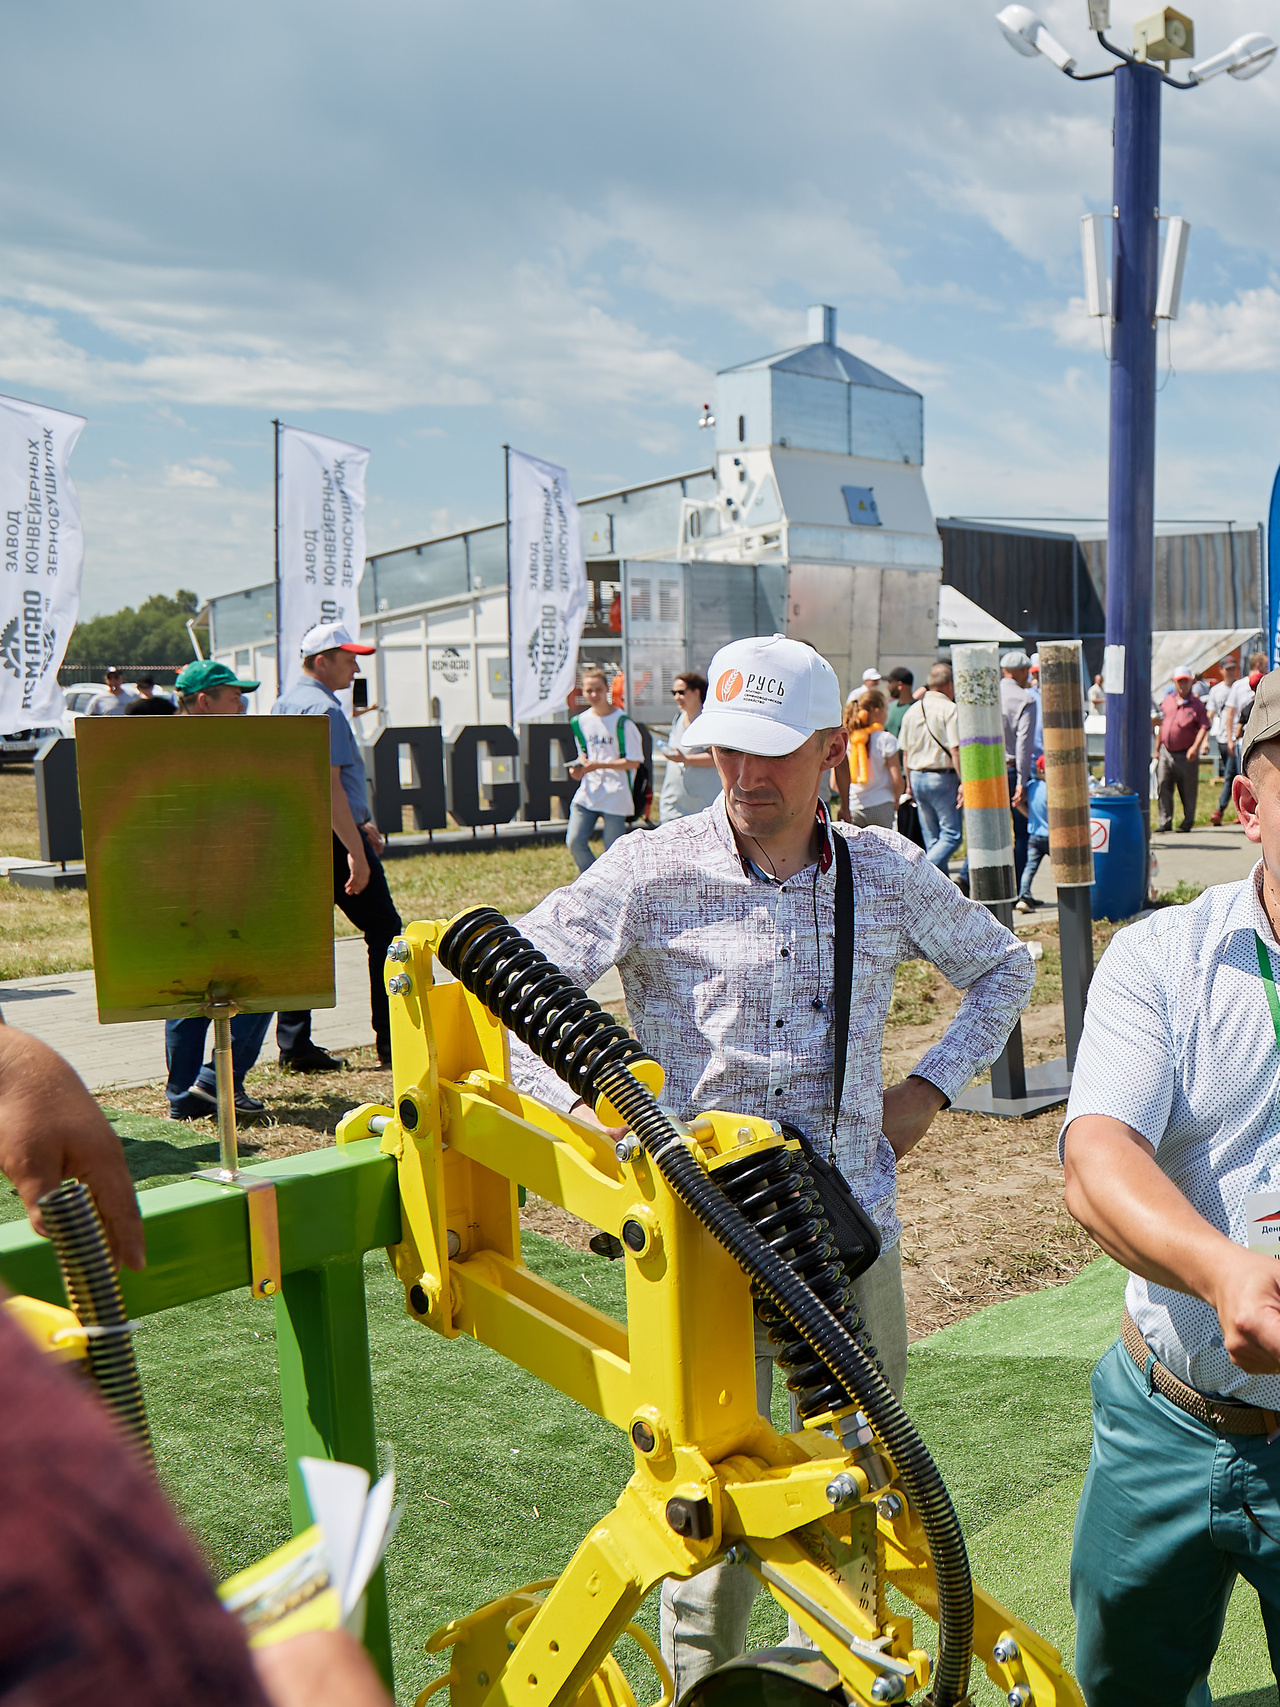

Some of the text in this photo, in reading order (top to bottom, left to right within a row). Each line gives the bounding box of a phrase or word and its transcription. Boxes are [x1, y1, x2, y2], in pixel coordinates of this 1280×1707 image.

[24, 438, 42, 575] КОНВЕЙЕРНЫХ
[43, 427, 59, 576] ЗЕРНОСУШИЛОК
[6, 510, 22, 573] ЗАВОД
[304, 529, 319, 585] ЗАВОД
[530, 542, 540, 589] ЗАВОД
[746, 674, 785, 697] РУСЬ
